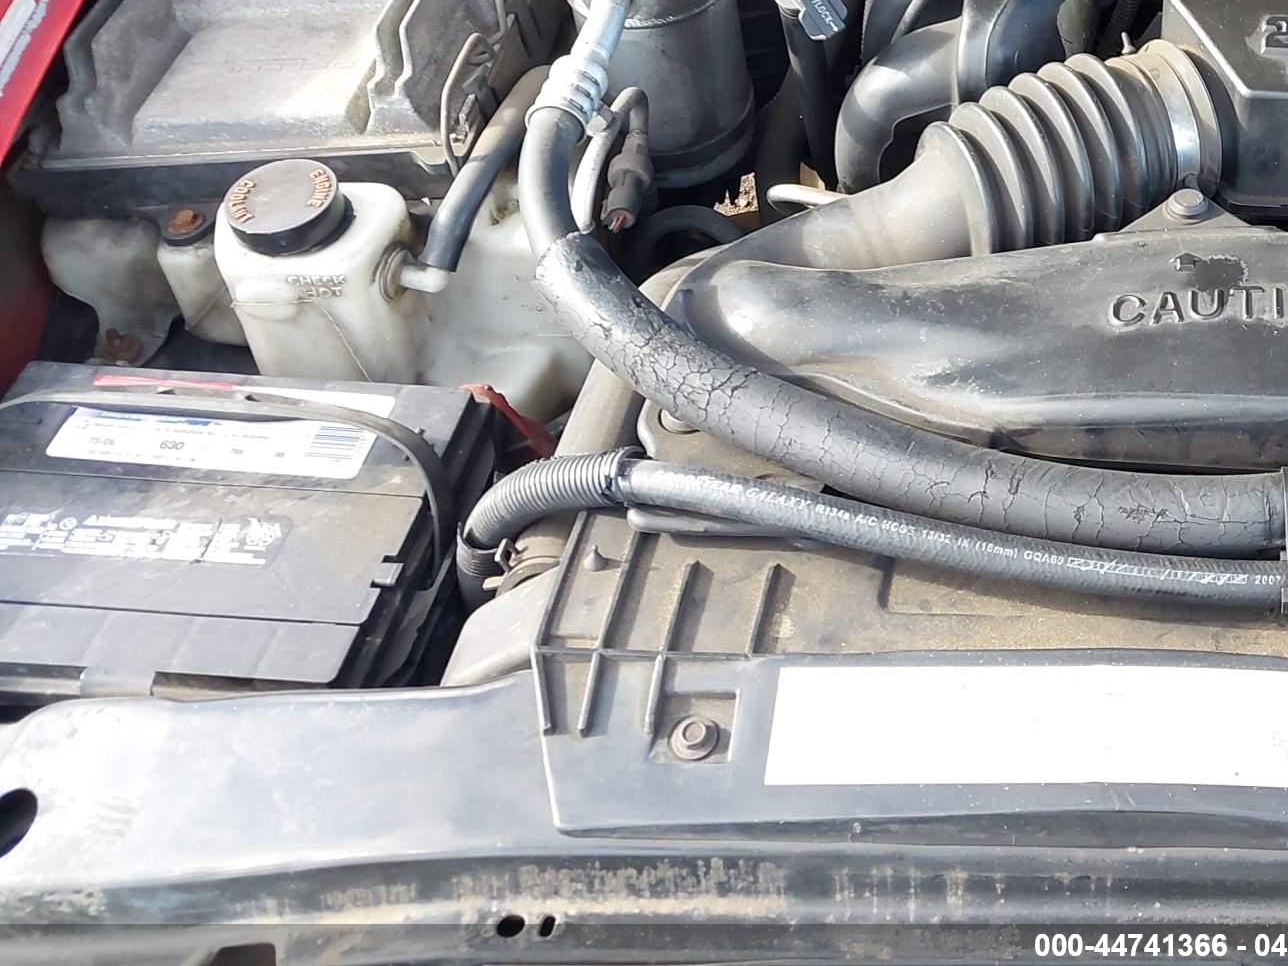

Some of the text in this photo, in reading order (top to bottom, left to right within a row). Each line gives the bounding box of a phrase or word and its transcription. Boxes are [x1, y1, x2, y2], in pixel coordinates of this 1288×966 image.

[227, 179, 257, 225] COOLANT
[307, 168, 333, 208] ENGINE
[286, 275, 347, 287] CHECK
[159, 440, 185, 451] 630
[745, 487, 812, 511] GALAXY
[853, 512, 877, 528] A/C
